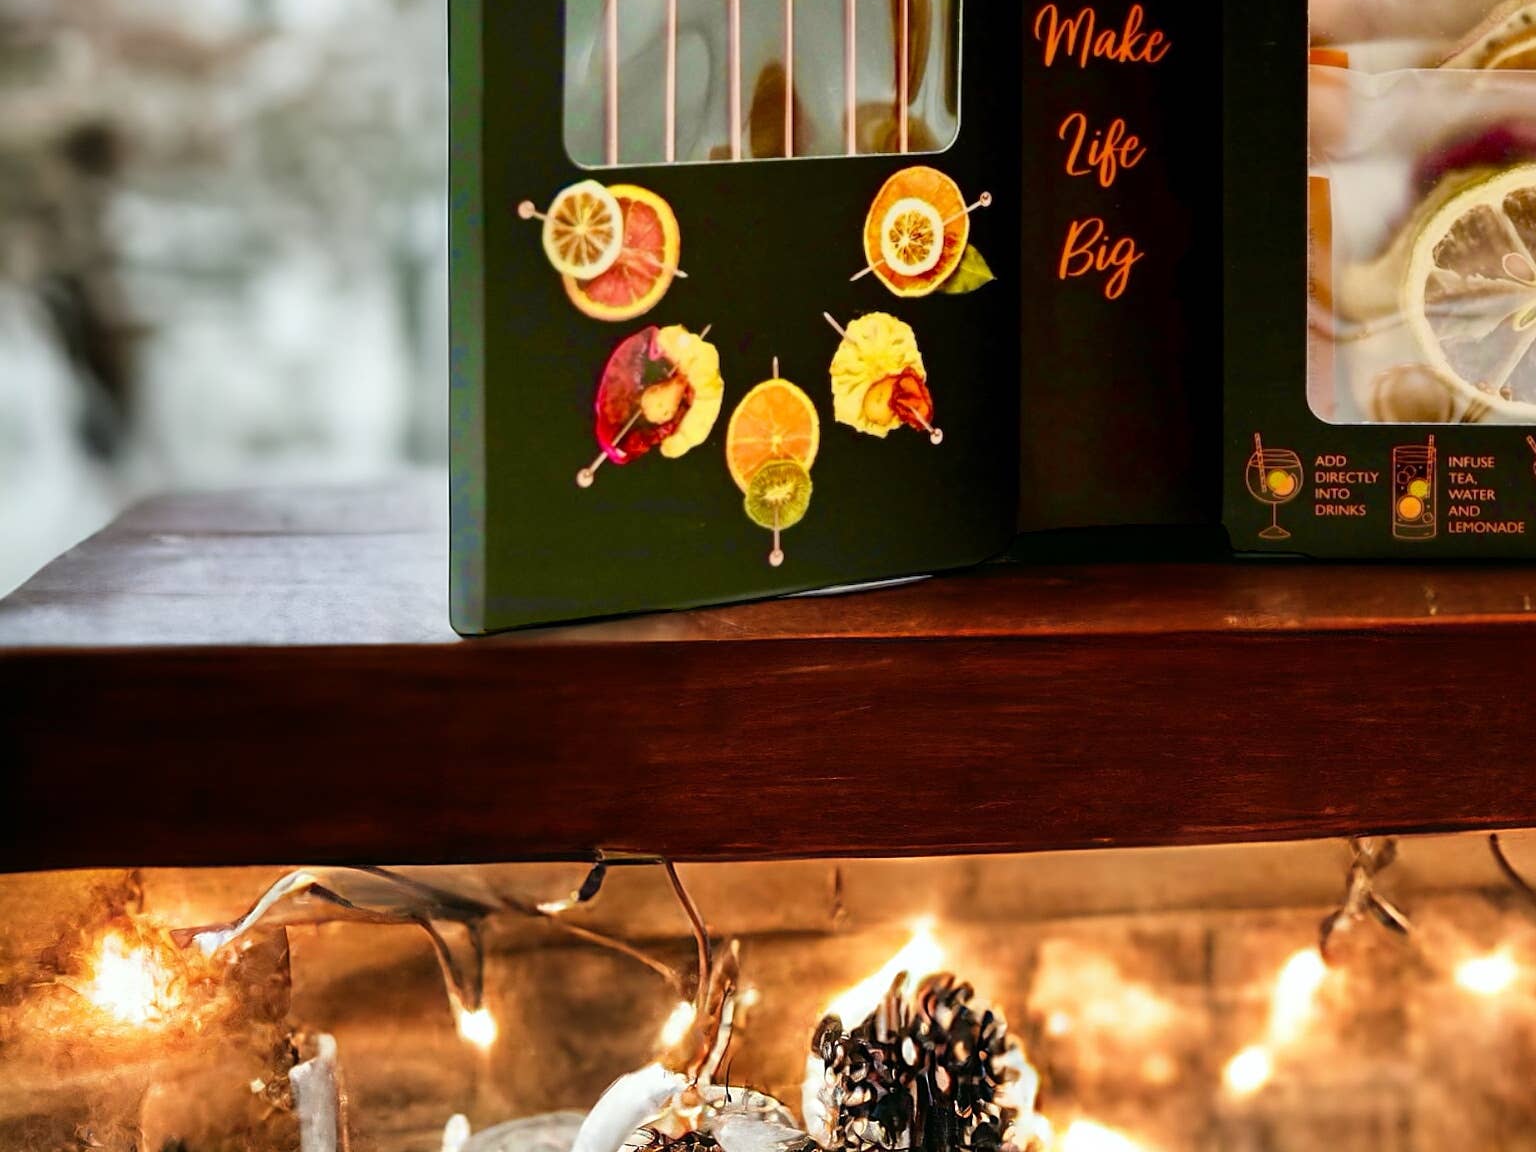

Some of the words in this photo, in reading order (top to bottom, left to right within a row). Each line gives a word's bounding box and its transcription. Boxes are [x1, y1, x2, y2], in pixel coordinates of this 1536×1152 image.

[1034, 4, 1170, 68] Make
[1058, 112, 1146, 188] Life
[1058, 218, 1144, 299] Big
[1315, 455, 1346, 467] ADD
[1449, 456, 1494, 468] INFUSE
[1315, 472, 1378, 483] DIRECTLY
[1315, 488, 1350, 499] INTO
[1449, 489, 1495, 500] WATER
[1315, 504, 1366, 516] DRINKS
[1449, 505, 1480, 517] AND
[1449, 521, 1524, 533] LEMONADE
